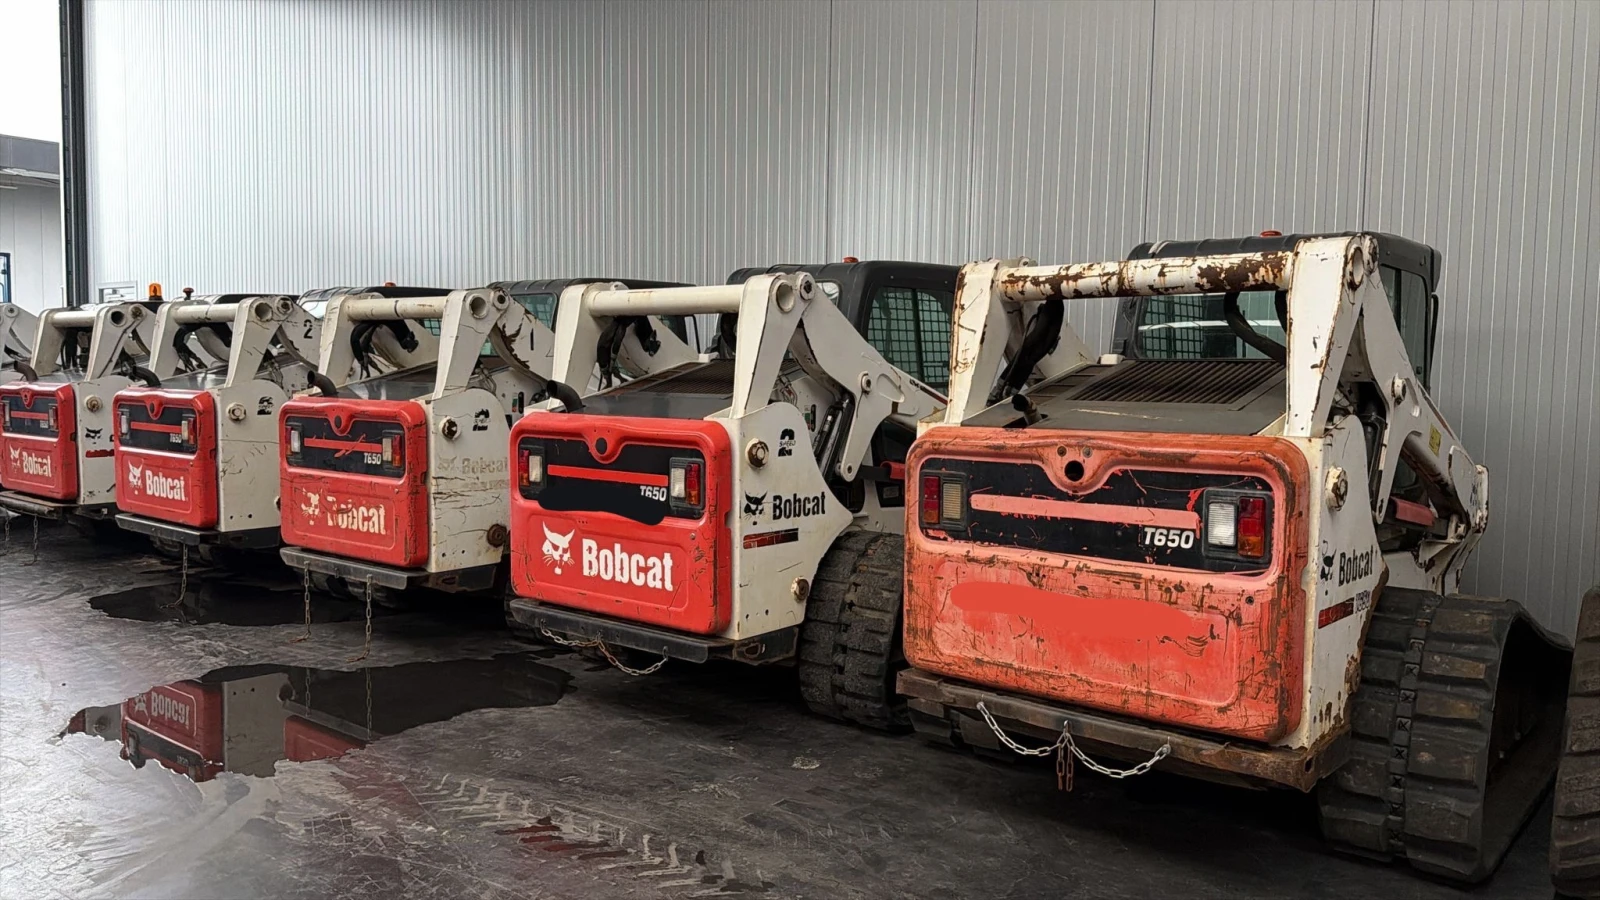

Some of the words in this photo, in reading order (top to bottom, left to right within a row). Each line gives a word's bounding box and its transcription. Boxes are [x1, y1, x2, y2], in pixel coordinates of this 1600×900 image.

[363, 452, 381, 465] T650
[145, 469, 186, 501] Bobcat
[640, 486, 667, 501] T650
[773, 491, 826, 520] Bobcat
[1144, 527, 1195, 549] T650
[582, 538, 673, 591] Bobcat
[1338, 545, 1374, 587] Bobcat
